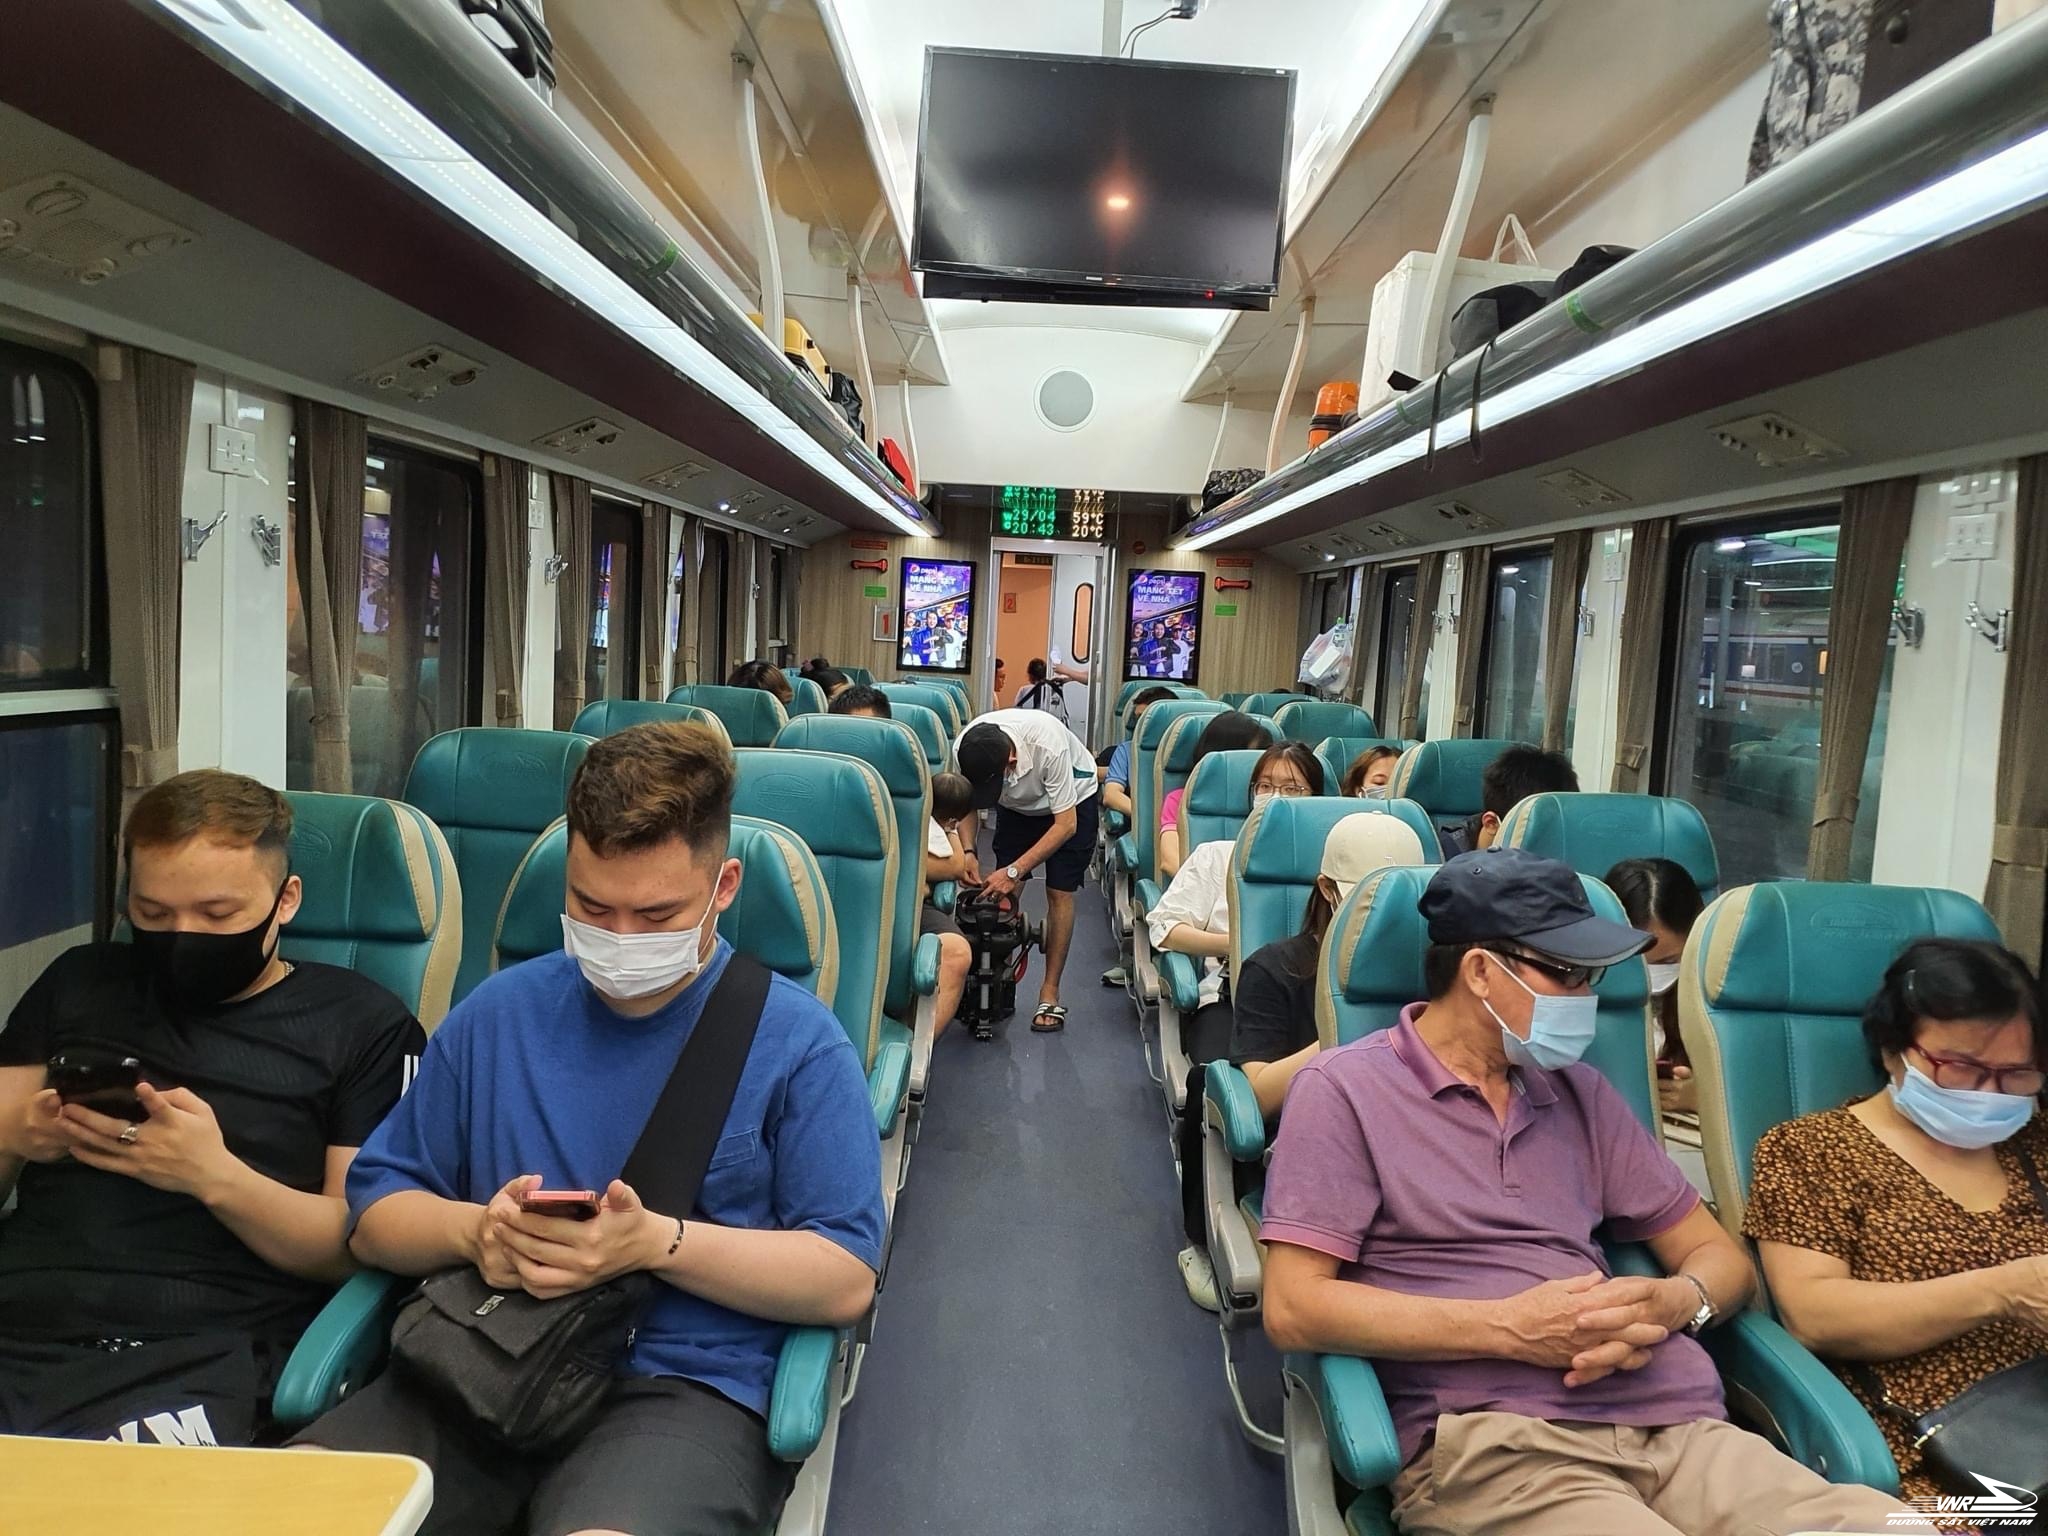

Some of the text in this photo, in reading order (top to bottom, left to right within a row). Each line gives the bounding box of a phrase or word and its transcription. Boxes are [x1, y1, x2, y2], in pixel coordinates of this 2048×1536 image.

[1013, 509, 1056, 522] 29/04
[1073, 511, 1104, 524] 59°C
[1012, 522, 1054, 536] 20:43
[1072, 525, 1103, 538] 20°C
[910, 575, 937, 584] MANG
[1137, 586, 1164, 594] MANG
[1007, 598, 1014, 610] 2
[883, 614, 889, 634] 1
